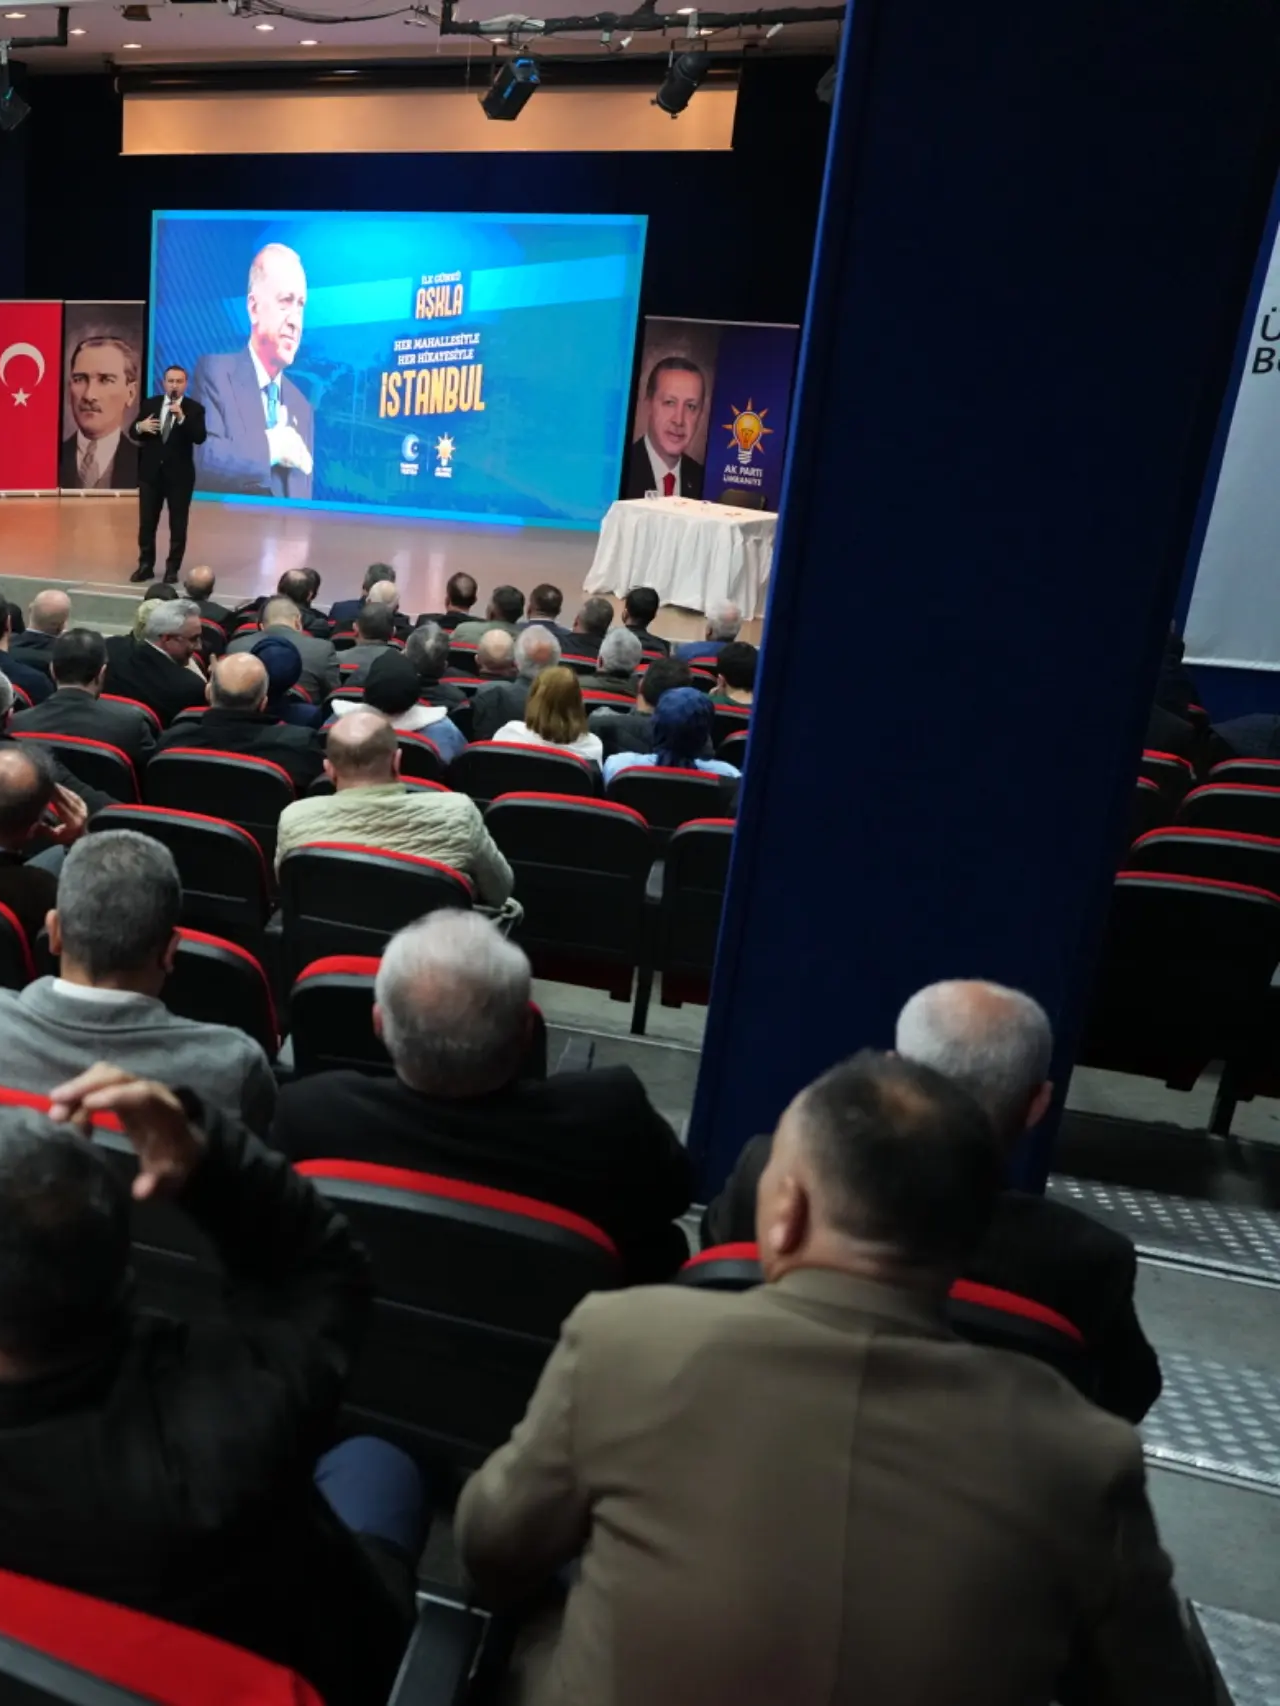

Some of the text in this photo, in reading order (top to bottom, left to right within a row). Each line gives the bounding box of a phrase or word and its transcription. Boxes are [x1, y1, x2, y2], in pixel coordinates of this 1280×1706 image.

[415, 284, 464, 320] AŞKLA
[394, 333, 480, 351] HER MAHALLESİYLE
[398, 353, 416, 366] HER
[379, 363, 485, 419] İSTANBUL
[723, 464, 738, 474] AK
